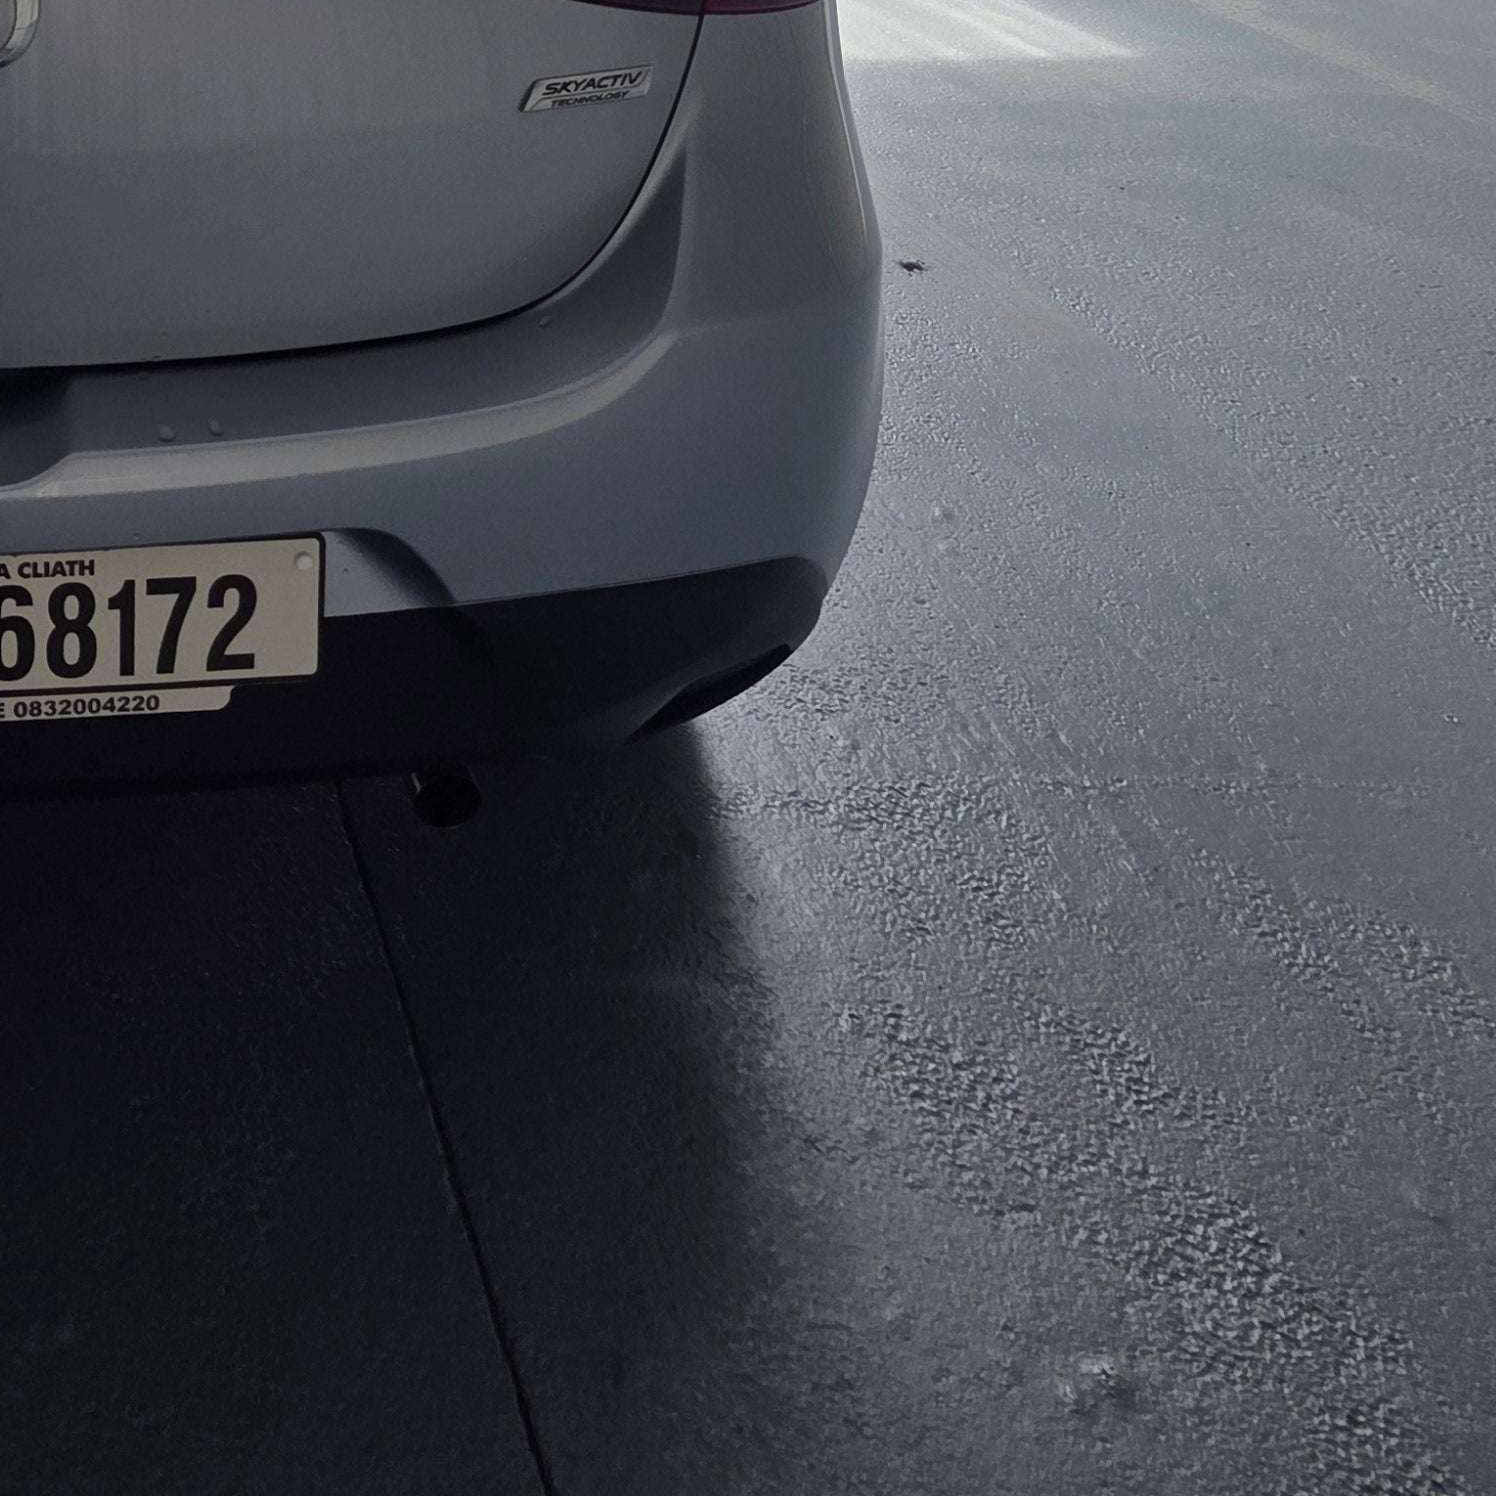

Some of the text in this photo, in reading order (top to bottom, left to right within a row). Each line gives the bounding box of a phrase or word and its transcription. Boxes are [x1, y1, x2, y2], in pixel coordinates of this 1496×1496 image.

[542, 71, 642, 96] SKYACTIV
[551, 90, 630, 107] TECHNOLOGY
[17, 559, 95, 579] CLIATH
[13, 695, 160, 718] 0832004220
